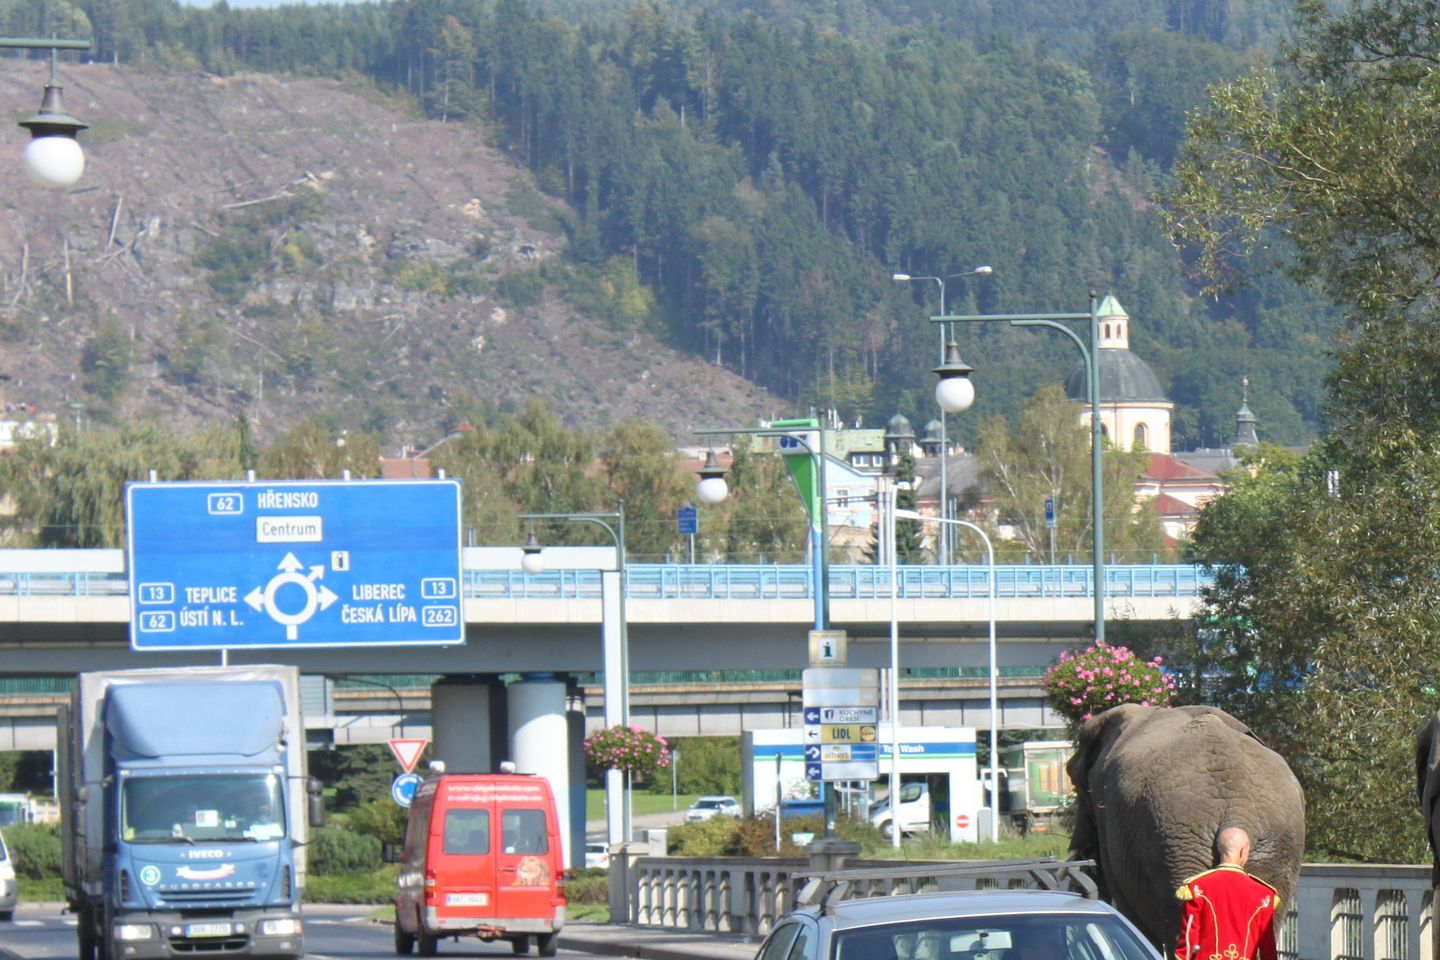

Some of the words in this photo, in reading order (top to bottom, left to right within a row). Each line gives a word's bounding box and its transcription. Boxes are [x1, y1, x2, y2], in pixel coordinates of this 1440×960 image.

[216, 497, 234, 511] 62
[257, 489, 319, 509] HŘENSKO
[262, 521, 317, 536] Centrum
[149, 586, 165, 600] 13
[185, 586, 238, 604] TEPLICE
[352, 583, 406, 600] LIBEREC
[431, 582, 447, 595] 13
[149, 614, 166, 628] 62
[179, 605, 210, 627] ÚSTÍ
[212, 610, 227, 626] N.
[230, 609, 244, 626] L.
[341, 603, 385, 624] ČESKÁ
[388, 602, 417, 623] LÍPA
[427, 609, 453, 623] 262
[832, 728, 852, 740] LIDL
[900, 744, 925, 753] Wash
[188, 849, 224, 859] IVECO
